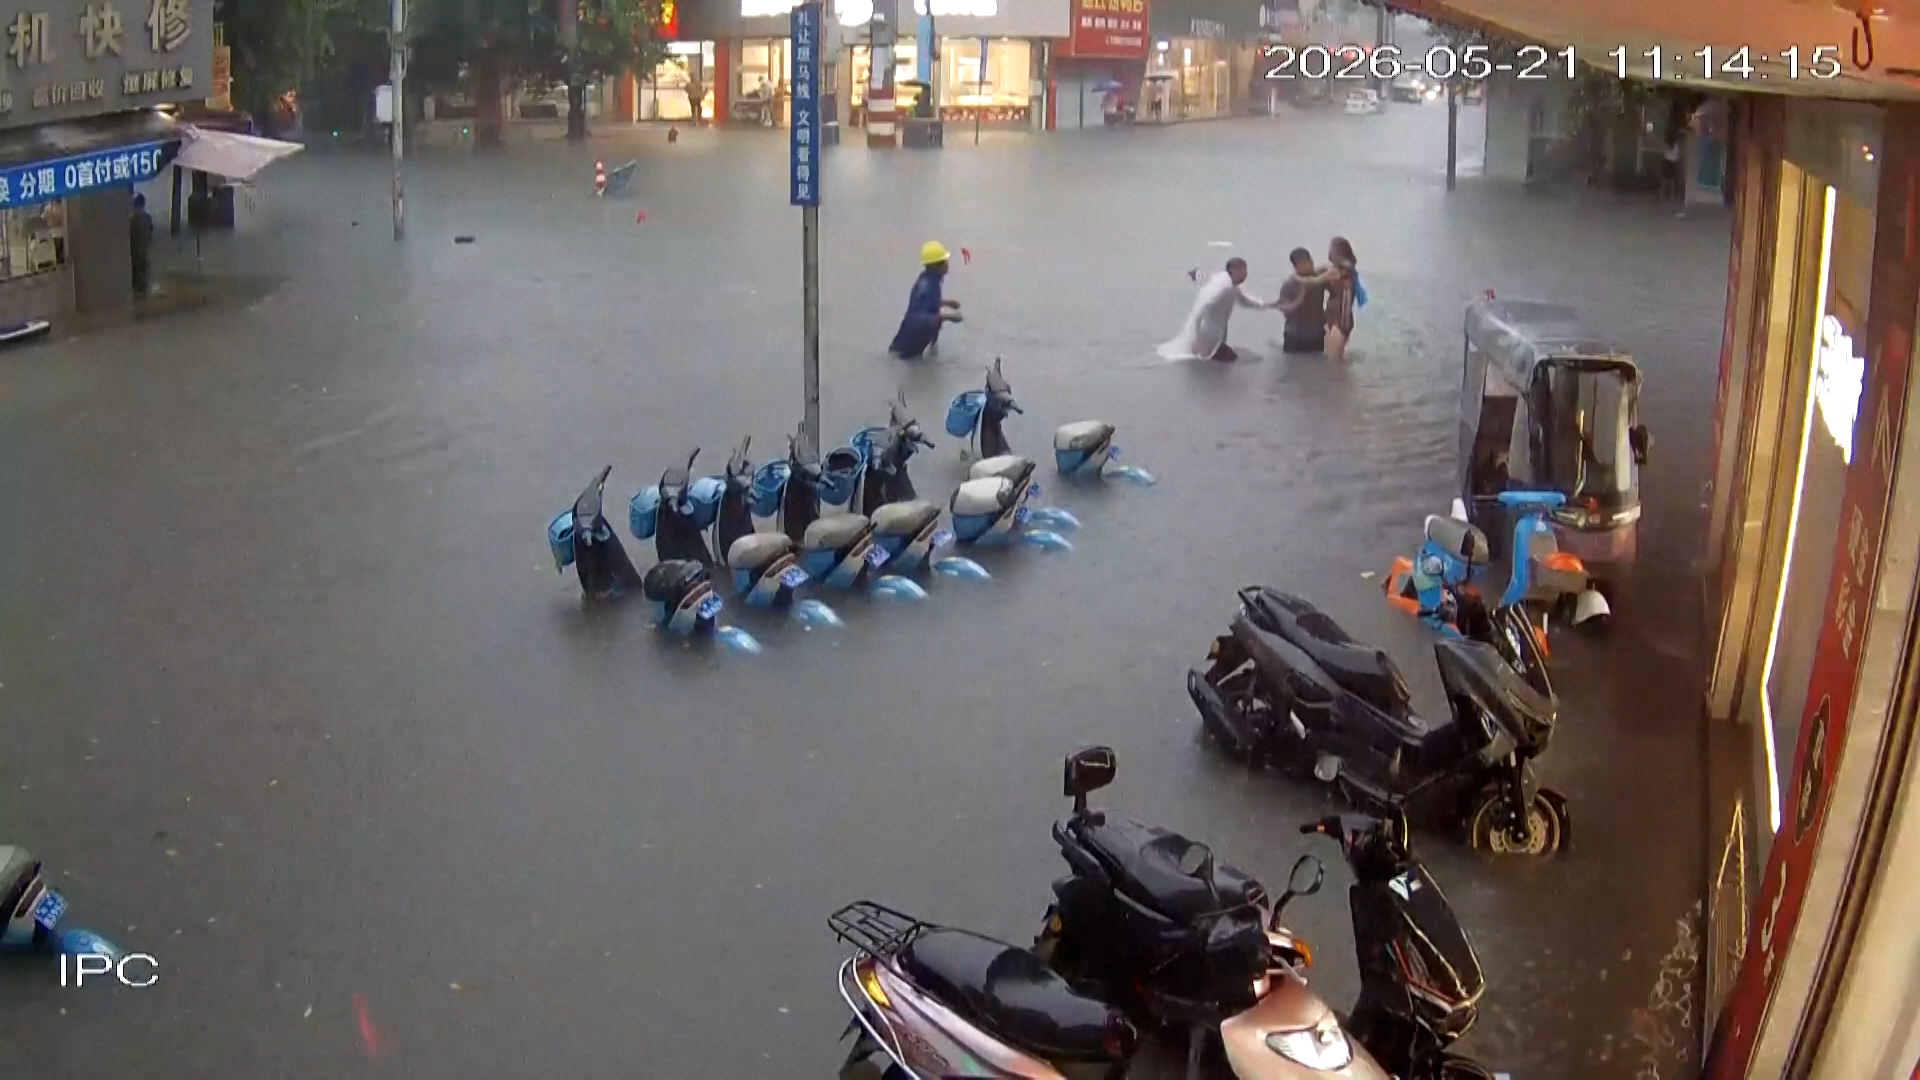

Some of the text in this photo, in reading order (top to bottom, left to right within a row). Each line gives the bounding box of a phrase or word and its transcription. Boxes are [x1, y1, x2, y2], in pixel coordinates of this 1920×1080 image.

[8, 0, 192, 68] 机快修
[20, 167, 55, 200] 分期
